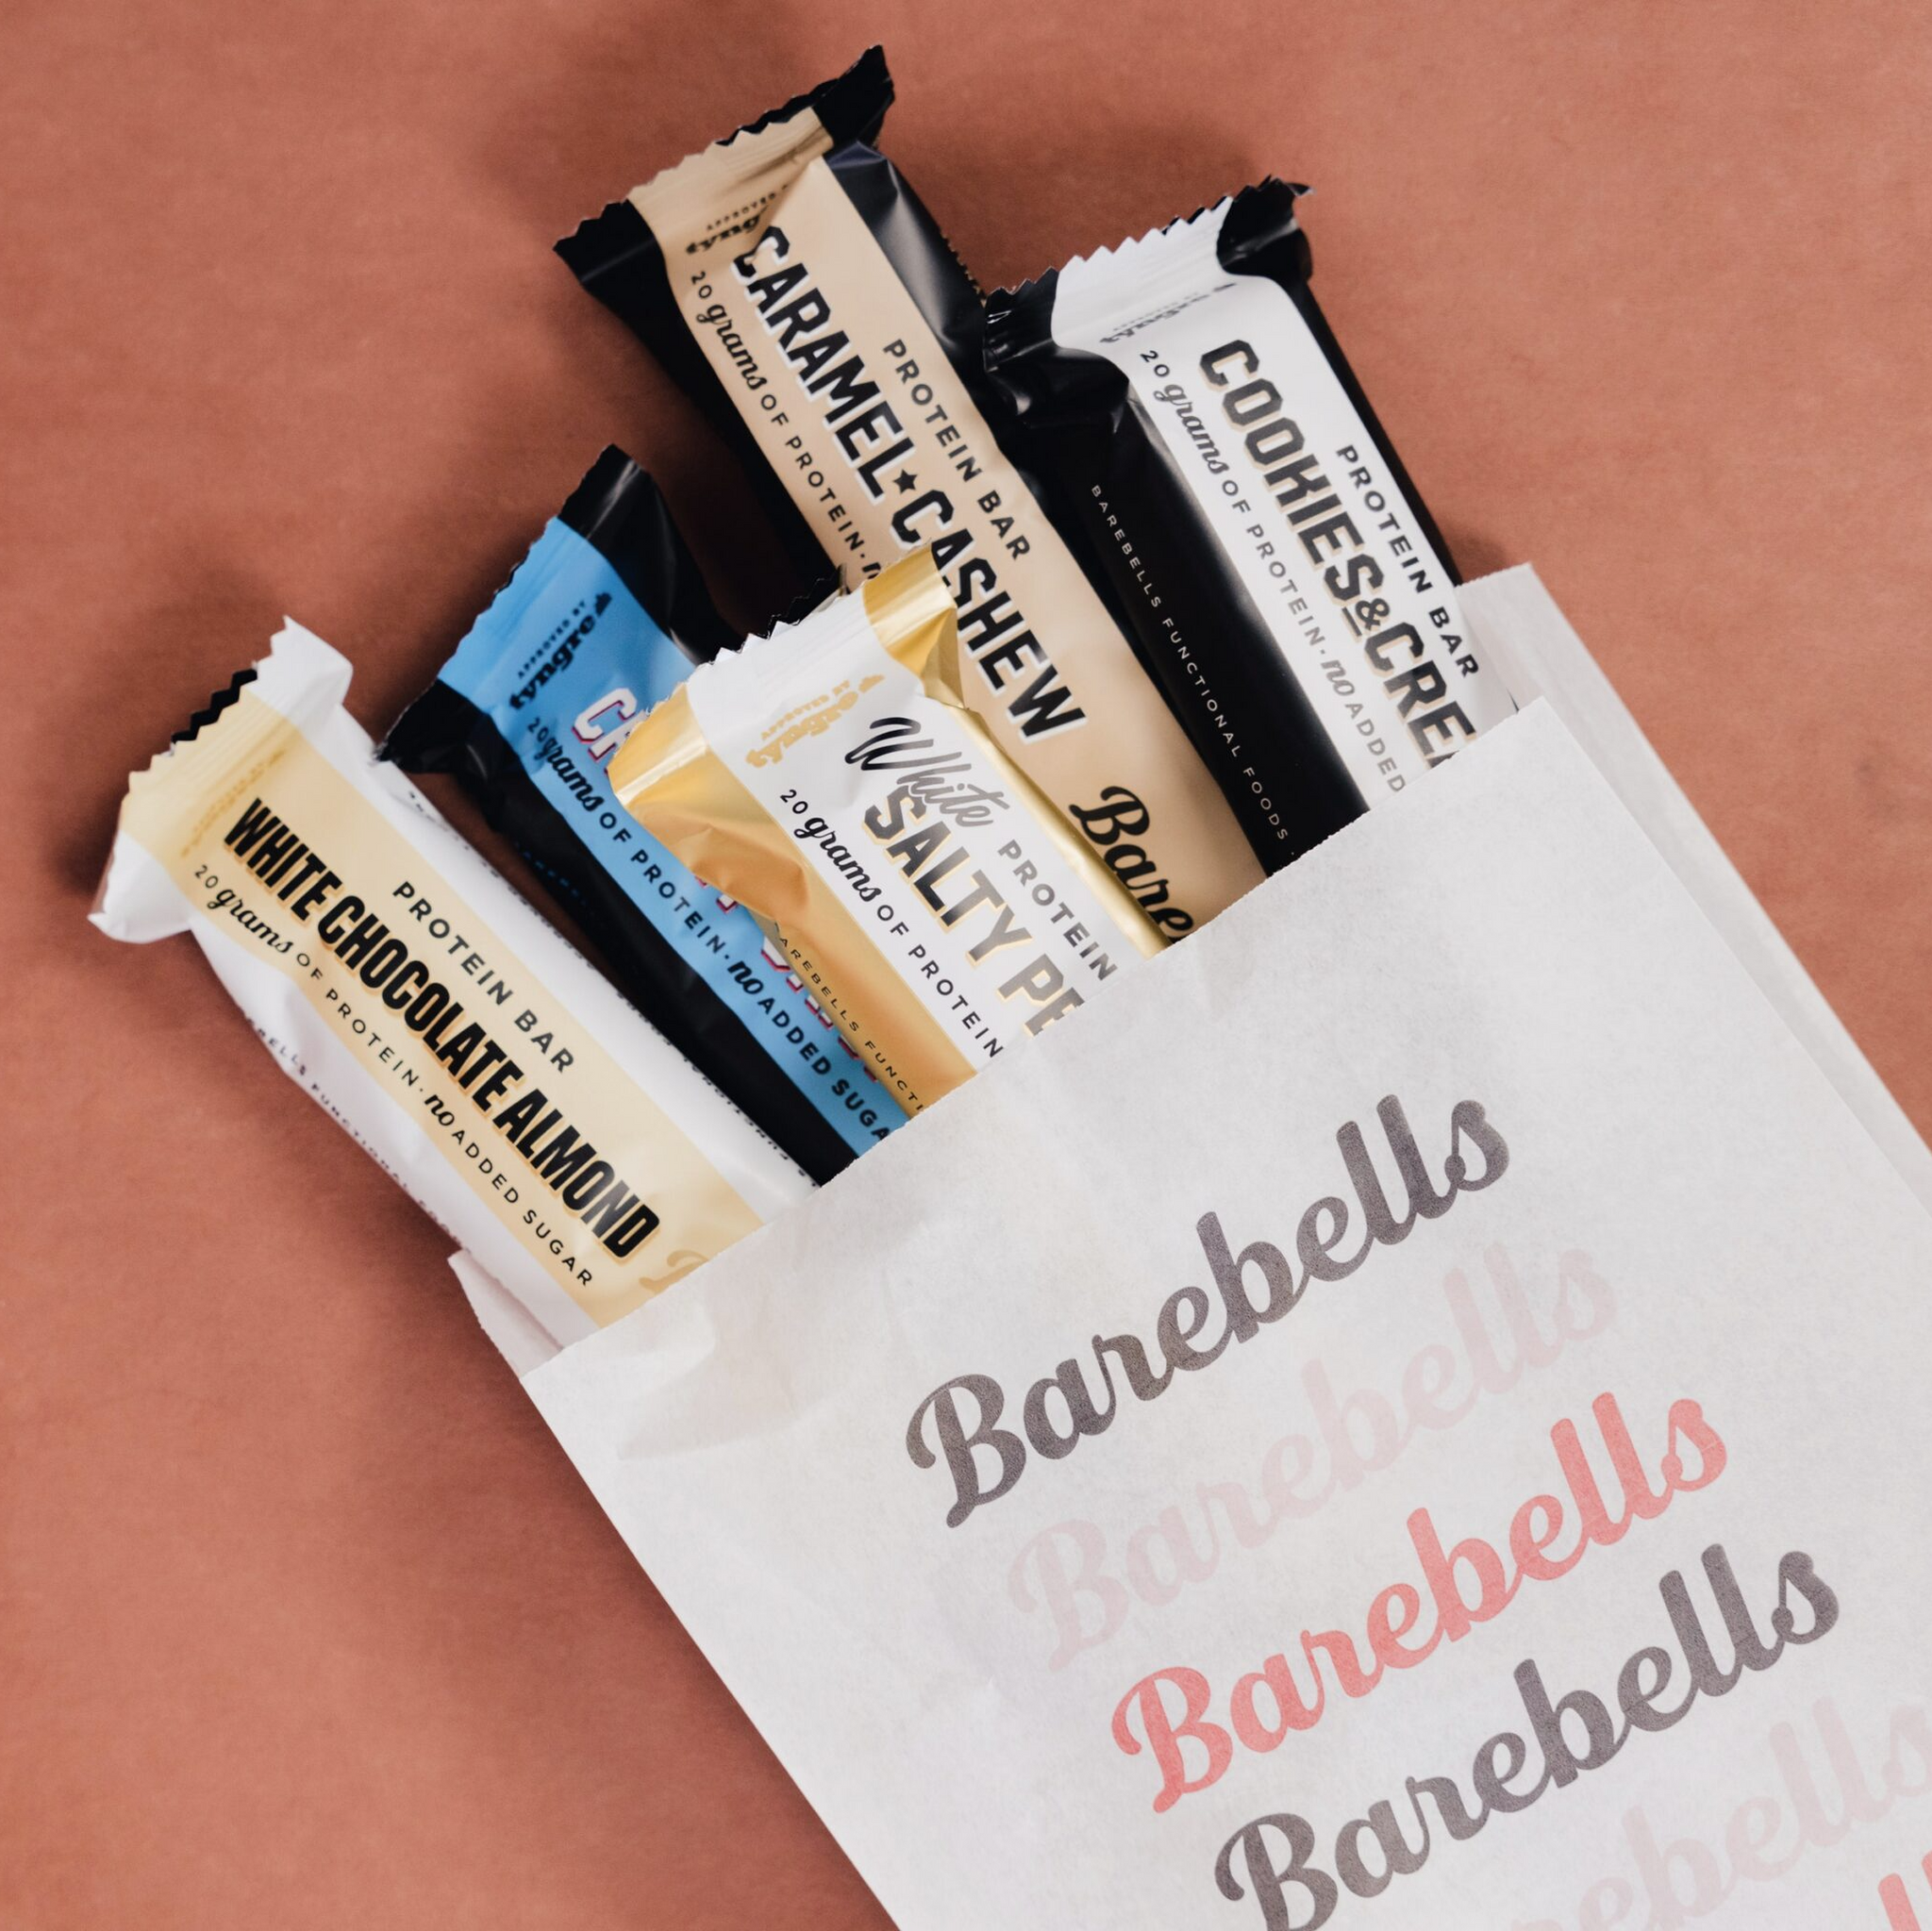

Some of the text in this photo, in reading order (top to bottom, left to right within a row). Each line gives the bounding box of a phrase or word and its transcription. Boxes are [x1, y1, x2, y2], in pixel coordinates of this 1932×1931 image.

[691, 270, 712, 299] 20
[695, 304, 768, 391] grams
[1140, 349, 1171, 378] 20
[759, 393, 790, 426] OF
[882, 338, 1032, 560] PROTEIN BAR
[1152, 383, 1230, 475] grams
[731, 225, 1088, 740] CARAMEL CASHEW
[1222, 479, 1252, 514] OF
[1336, 444, 1480, 678] PROTEIN BAR
[1091, 484, 1289, 841] BAREBELLS FUNCTIONAL FOODS
[1321, 658, 1356, 697] no
[1363, 621, 1477, 769] CRE
[526, 716, 549, 742] 20
[533, 736, 606, 813] grams
[843, 716, 1010, 828] White
[1344, 702, 1407, 792] ADDED
[599, 811, 633, 844] OF
[779, 788, 808, 815] 20
[793, 816, 883, 903] grams
[862, 783, 1034, 965] SALTY
[997, 838, 1119, 982] PROTEIN
[876, 904, 910, 938] OF
[224, 796, 344, 924] WHITE
[317, 894, 525, 1114] CHOCOLATE
[491, 1088, 660, 1259] ALMOND
[391, 880, 514, 1007] PROTEIN
[513, 1008, 575, 1074] BAR
[726, 959, 765, 995] no
[774, 922, 859, 1033] AREBELLS
[908, 943, 1005, 1058] PROTEIN
[193, 864, 219, 890] 20
[206, 888, 294, 955] grams
[295, 952, 324, 981] OF
[424, 1093, 456, 1127] no
[451, 1129, 520, 1205] ADDED
[522, 1208, 593, 1287] SUGAR
[757, 996, 832, 1075] ADDED
[904, 1092, 1510, 1529] Barebells
[1007, 1241, 1619, 1673] Barebells
[1110, 1390, 1729, 1814] Barebells
[1213, 1541, 1840, 1931] Barebells
[1511, 1697, 1932, 1931] ebells
